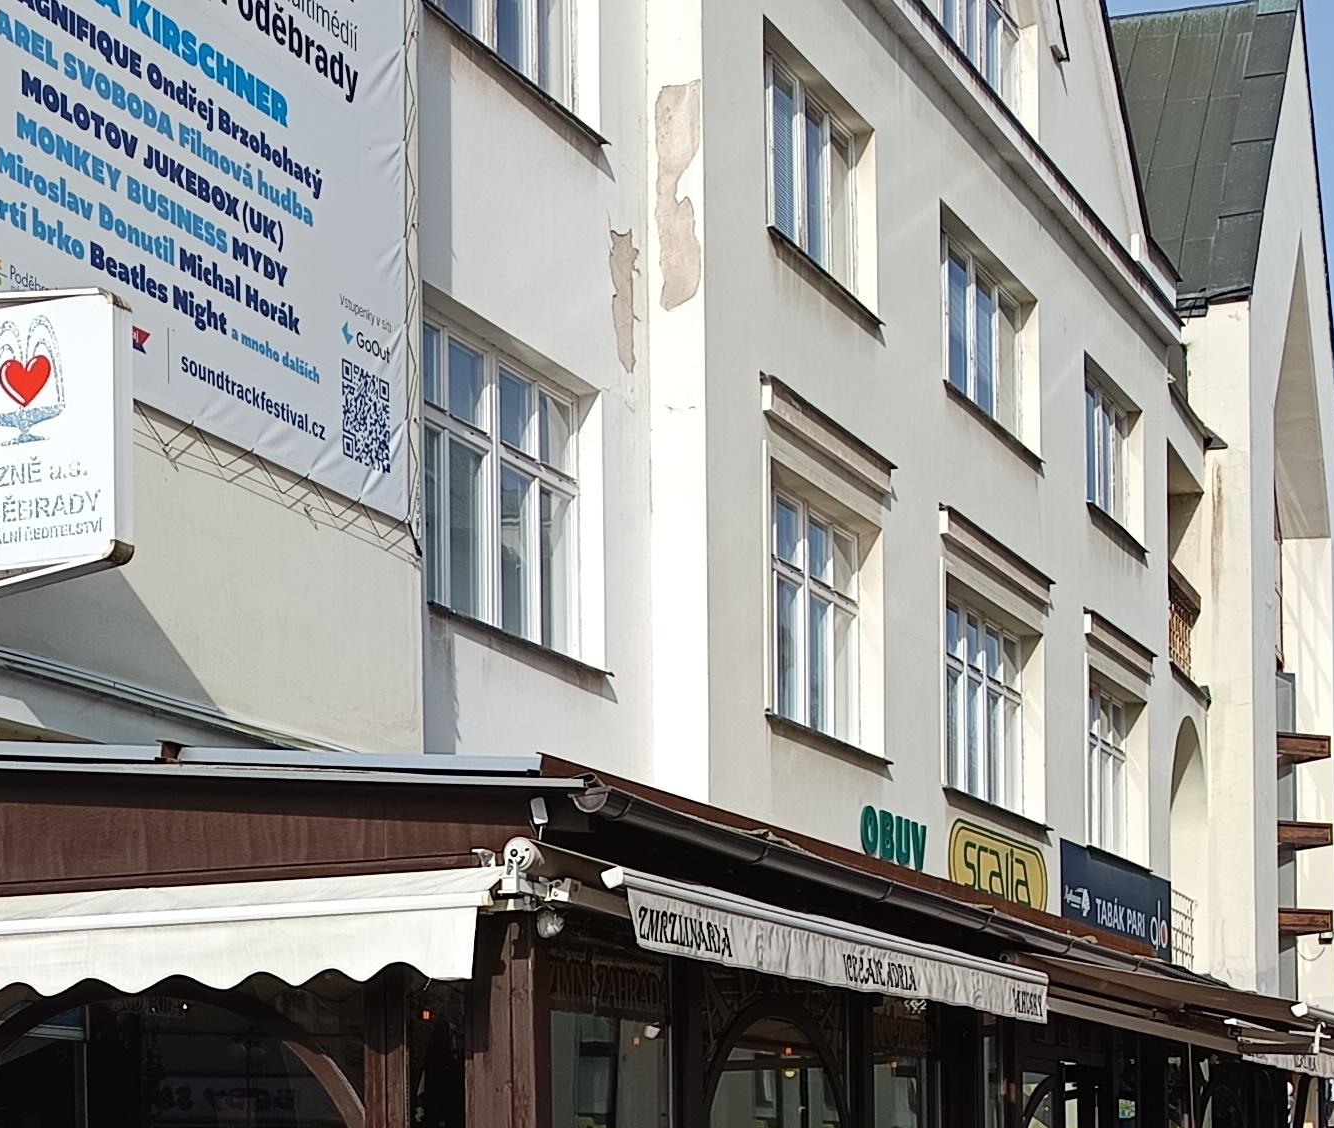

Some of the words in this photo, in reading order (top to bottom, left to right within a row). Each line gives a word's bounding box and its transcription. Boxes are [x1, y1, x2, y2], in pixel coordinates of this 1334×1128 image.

[129, 0, 289, 128] KIRSCHNER
[21, 68, 138, 159] MOLOTOV
[143, 145, 240, 219] JUKEBOX
[242, 202, 284, 253] (UK)
[64, 51, 174, 141] SVOBODA
[179, 127, 253, 190] Filmová
[256, 169, 314, 228] hudba
[147, 62, 214, 131] Ondřej
[218, 106, 322, 199] Brzobohatý
[15, 111, 122, 193] MONKEY
[127, 174, 229, 254] BUSINESS
[232, 236, 288, 288] MYDY
[32, 207, 85, 261] brko
[89, 240, 168, 304] Beatles
[172, 284, 228, 335] Night
[241, 331, 280, 364] mnoho
[98, 201, 175, 267] Donutil
[179, 247, 241, 302] Michal
[245, 283, 301, 336] Horák
[181, 355, 326, 441] soundtrackfestival.cz
[357, 331, 391, 364] GoOut
[860, 804, 927, 872] OBUV
[888, 962, 917, 991] ADRIA
[1095, 897, 1125, 932] TABÁK
[1150, 900, 1168, 951] glo
